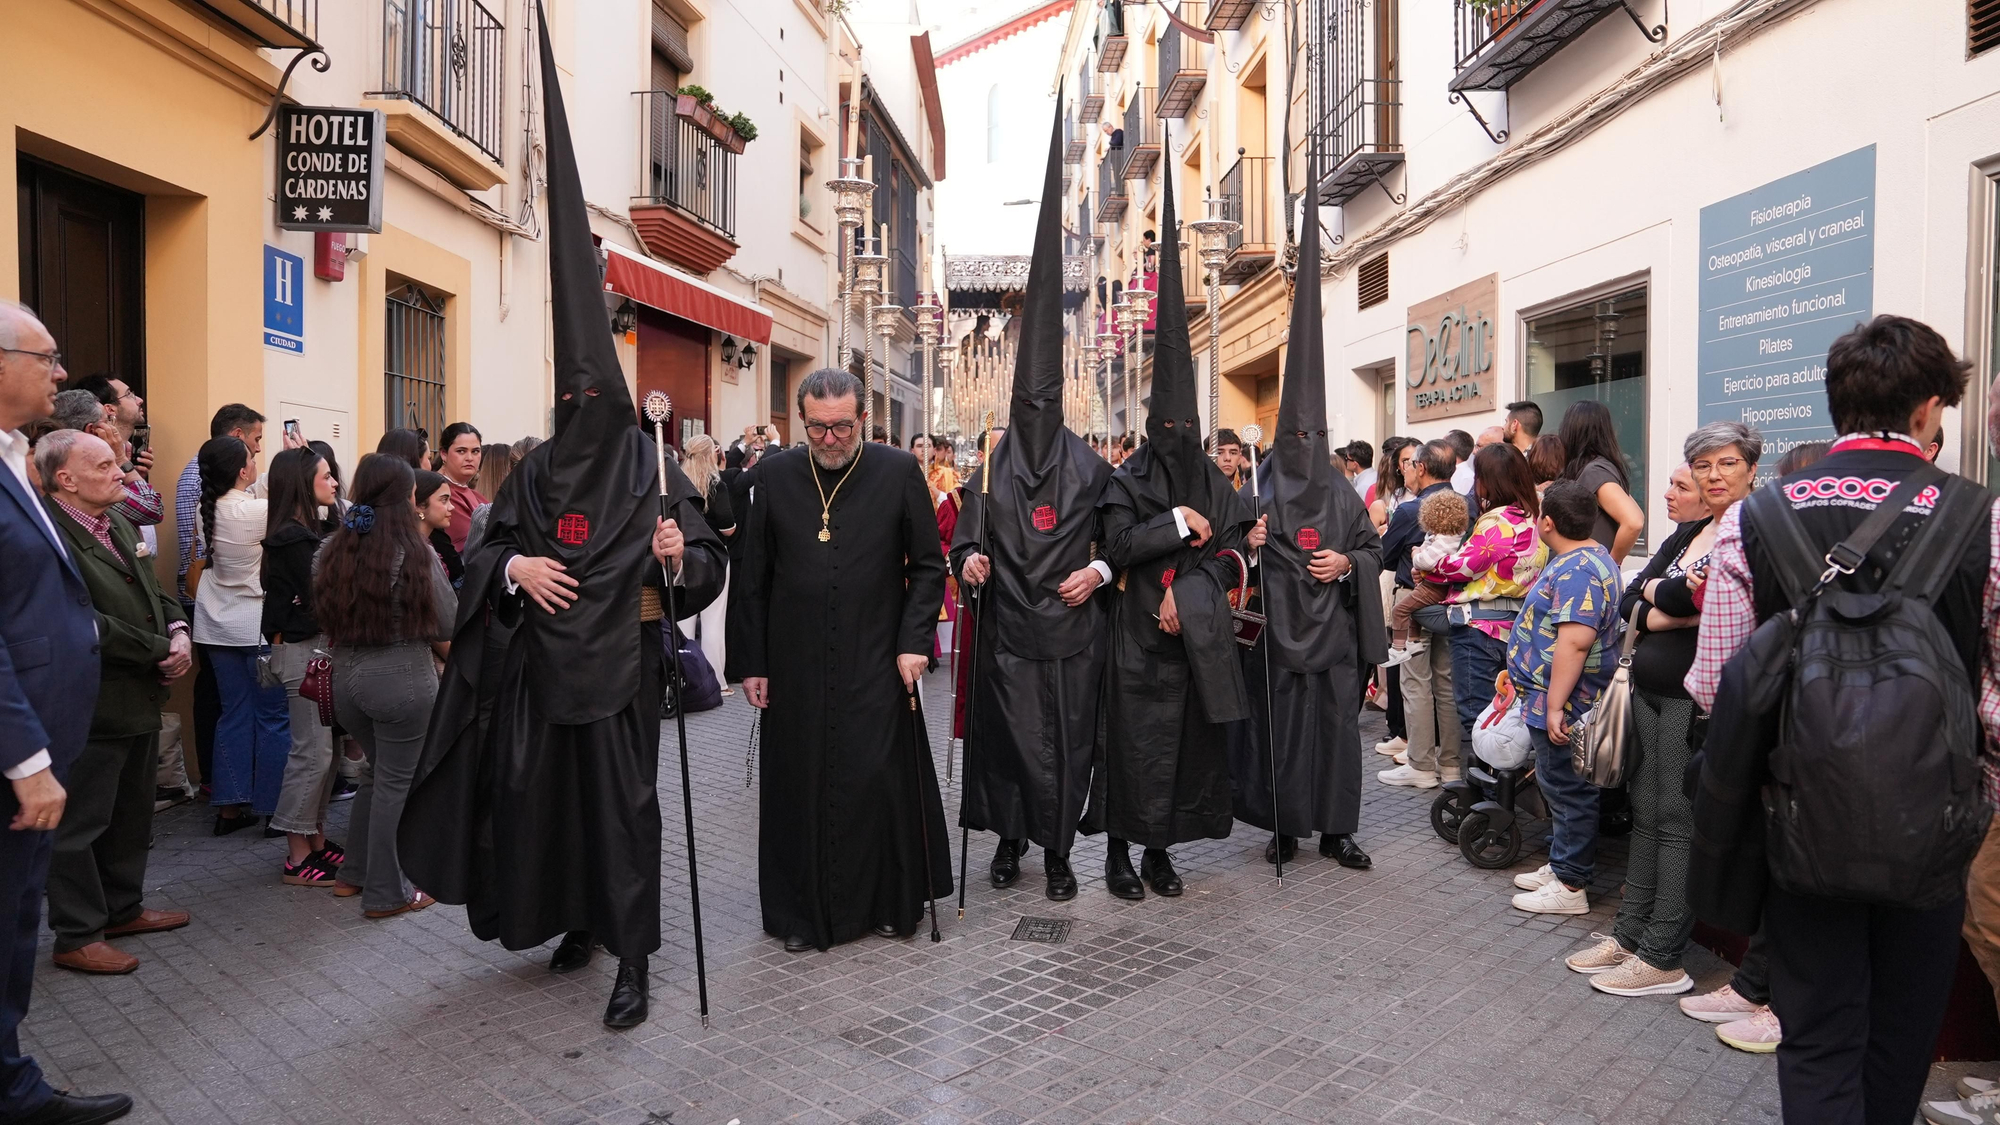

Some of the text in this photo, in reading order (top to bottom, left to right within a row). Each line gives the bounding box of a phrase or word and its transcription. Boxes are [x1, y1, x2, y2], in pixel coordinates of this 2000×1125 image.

[290, 114, 368, 146] HOTEL
[286, 151, 368, 173] CONDE DE
[285, 172, 368, 200] CÁRDENAS
[1750, 194, 1812, 227] Fisioterapia
[1708, 210, 1865, 271] Osteopatía, visceral y craneal
[274, 256, 293, 306] H
[1746, 262, 1812, 293] Kinesiología
[1719, 287, 1846, 331] Entrenamiento funcional
[270, 335, 297, 349] CIUDAD
[1759, 337, 1793, 355] Pilates
[1415, 381, 1482, 408] TERAPIA ACTIVA
[1724, 364, 1829, 396] Ejercicio para adulto
[1741, 403, 1812, 426] Hipopresivos
[1782, 476, 1940, 508] OCOCR
